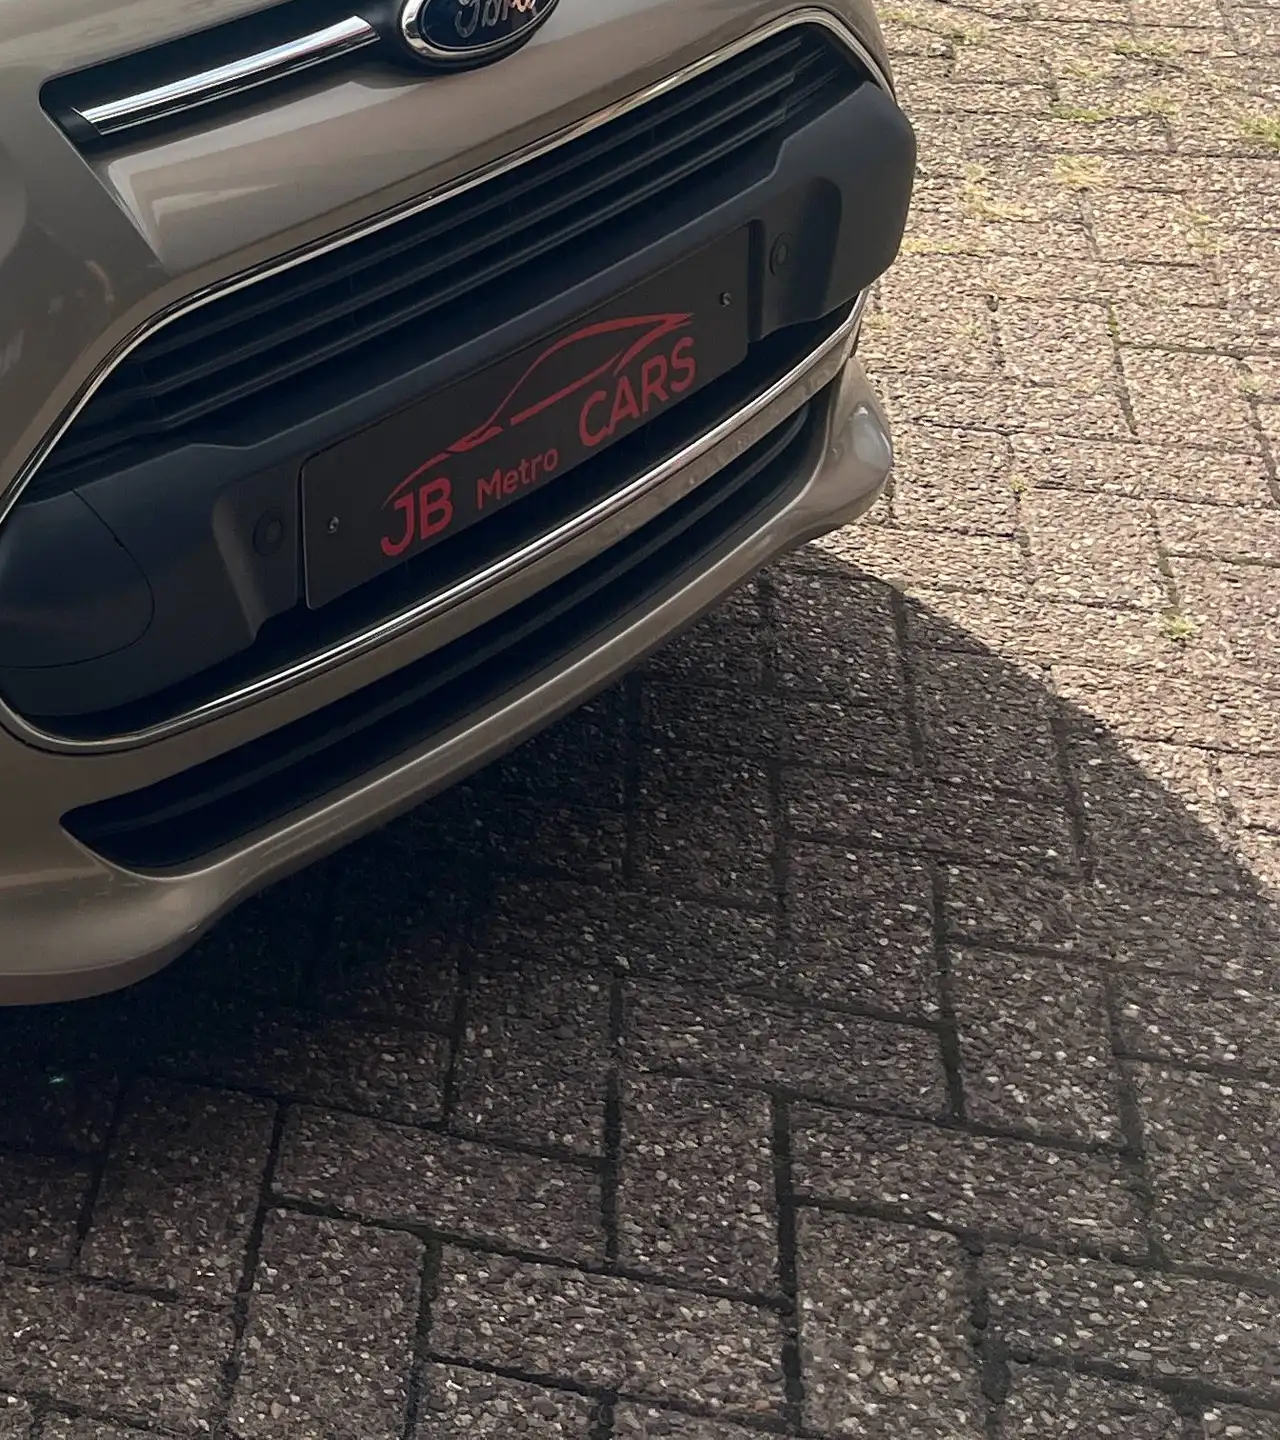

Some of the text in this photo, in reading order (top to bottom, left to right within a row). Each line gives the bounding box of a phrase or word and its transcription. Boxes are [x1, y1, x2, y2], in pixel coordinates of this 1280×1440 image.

[380, 336, 697, 558] JB Metro CARS
